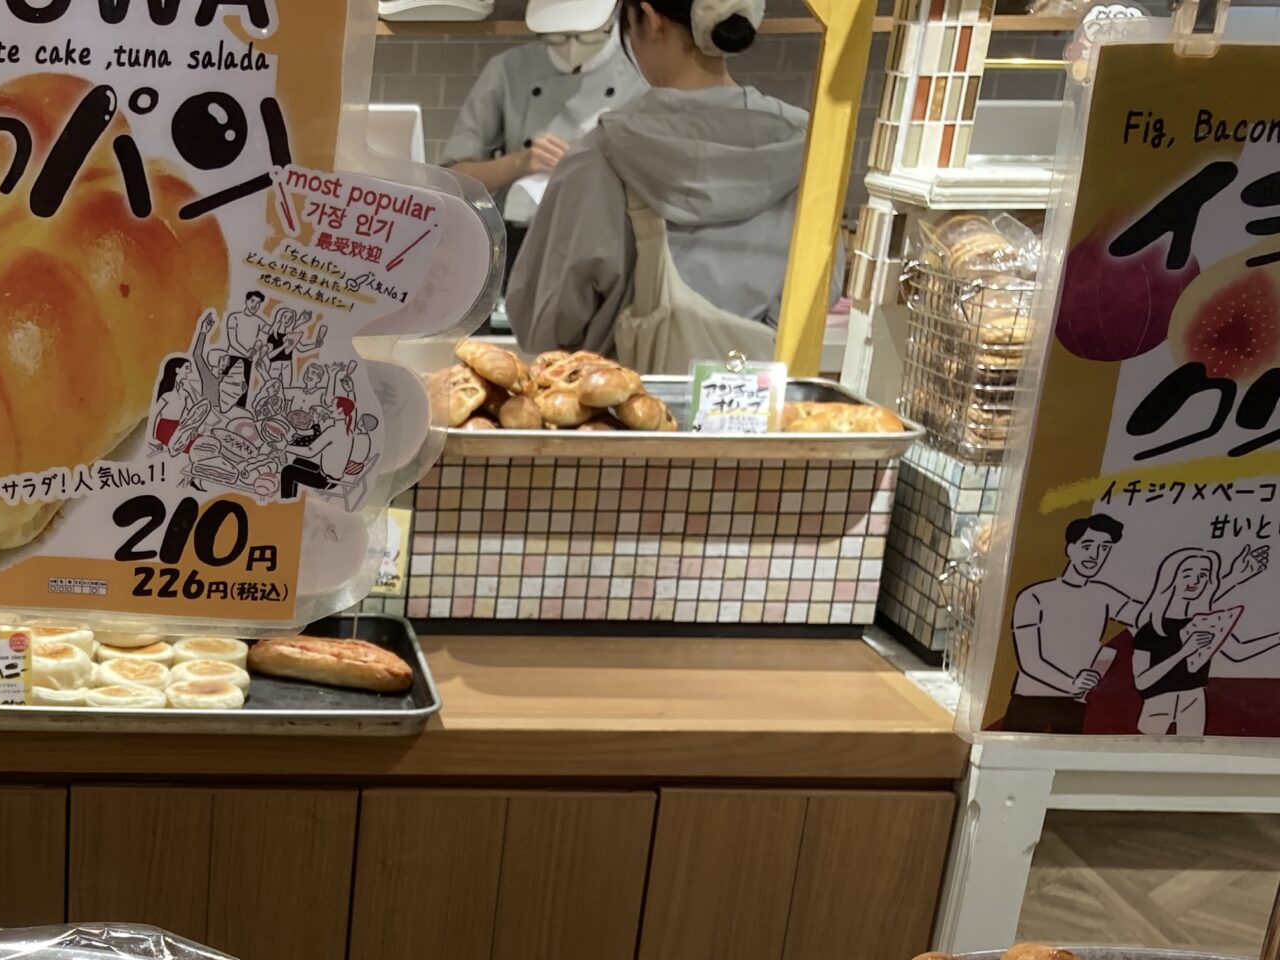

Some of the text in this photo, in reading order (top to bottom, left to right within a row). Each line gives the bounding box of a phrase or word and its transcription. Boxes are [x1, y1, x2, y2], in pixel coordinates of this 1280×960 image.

[35, 38, 92, 67] cake
[187, 39, 270, 73] salada
[1123, 109, 1175, 149] Fig,
[285, 169, 436, 222] most popular
[306, 201, 395, 243] 가장 인기
[314, 232, 384, 265] 最受欢迎
[245, 251, 342, 292] どんぐりで生まれた
[112, 494, 278, 573] 210円
[132, 566, 289, 602] 226円(税込)
